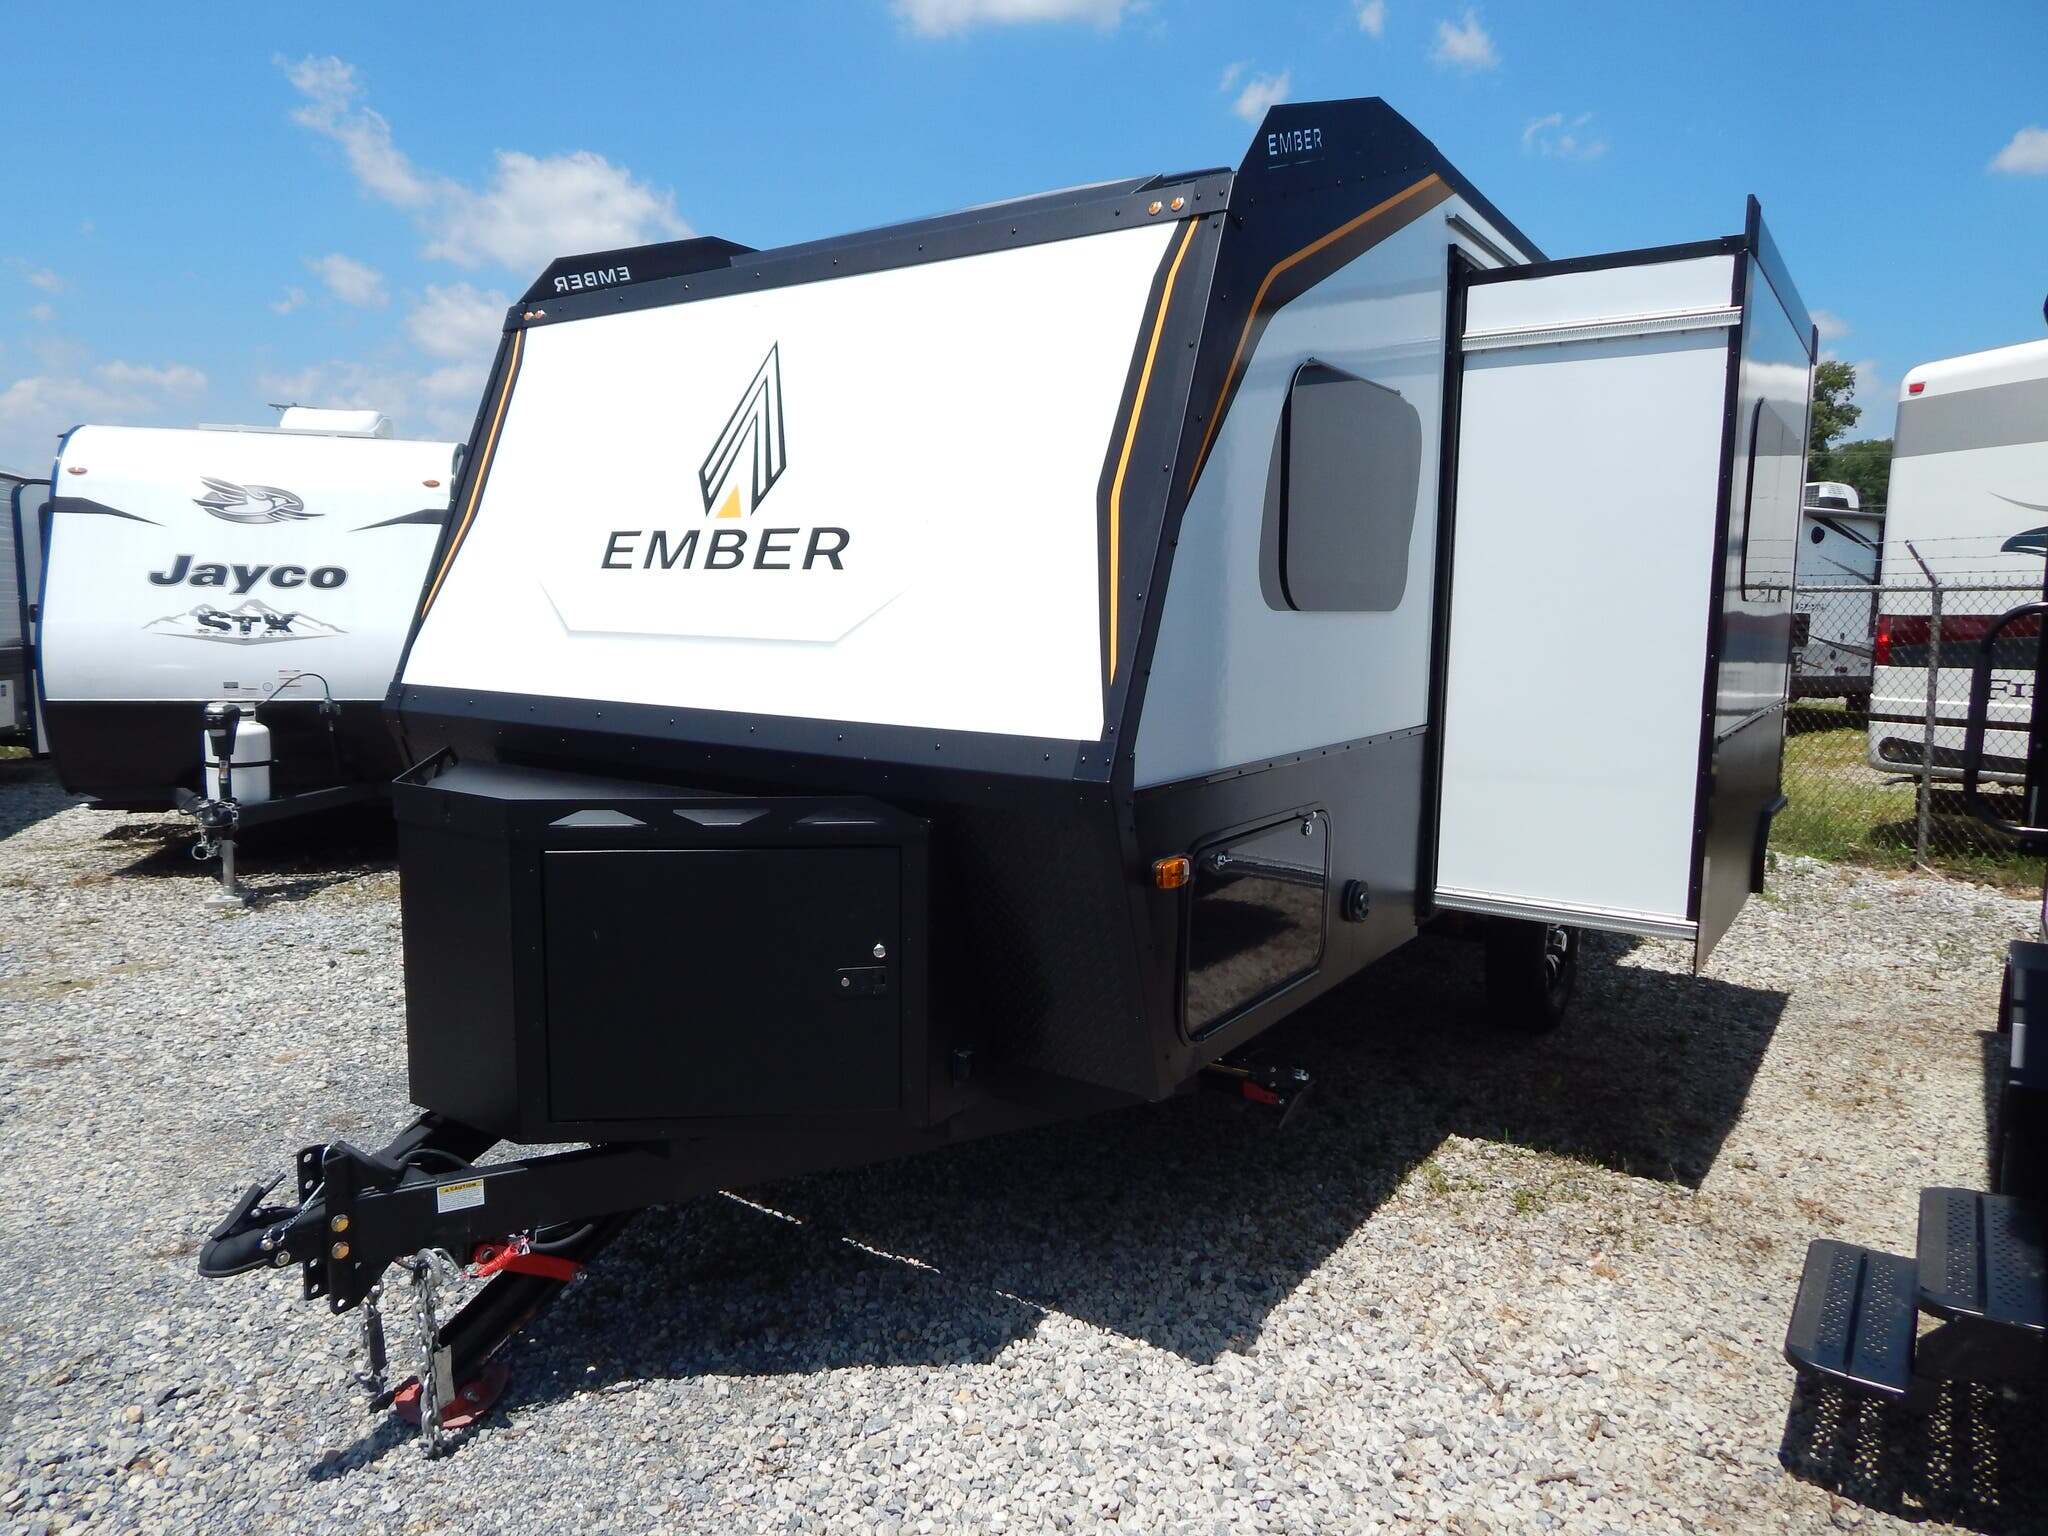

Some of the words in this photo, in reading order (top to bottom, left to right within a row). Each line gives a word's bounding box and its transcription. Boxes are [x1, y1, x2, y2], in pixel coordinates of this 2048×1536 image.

[1267, 128, 1323, 156] EMBER
[600, 527, 850, 571] EMBER
[147, 553, 349, 596] Jayco
